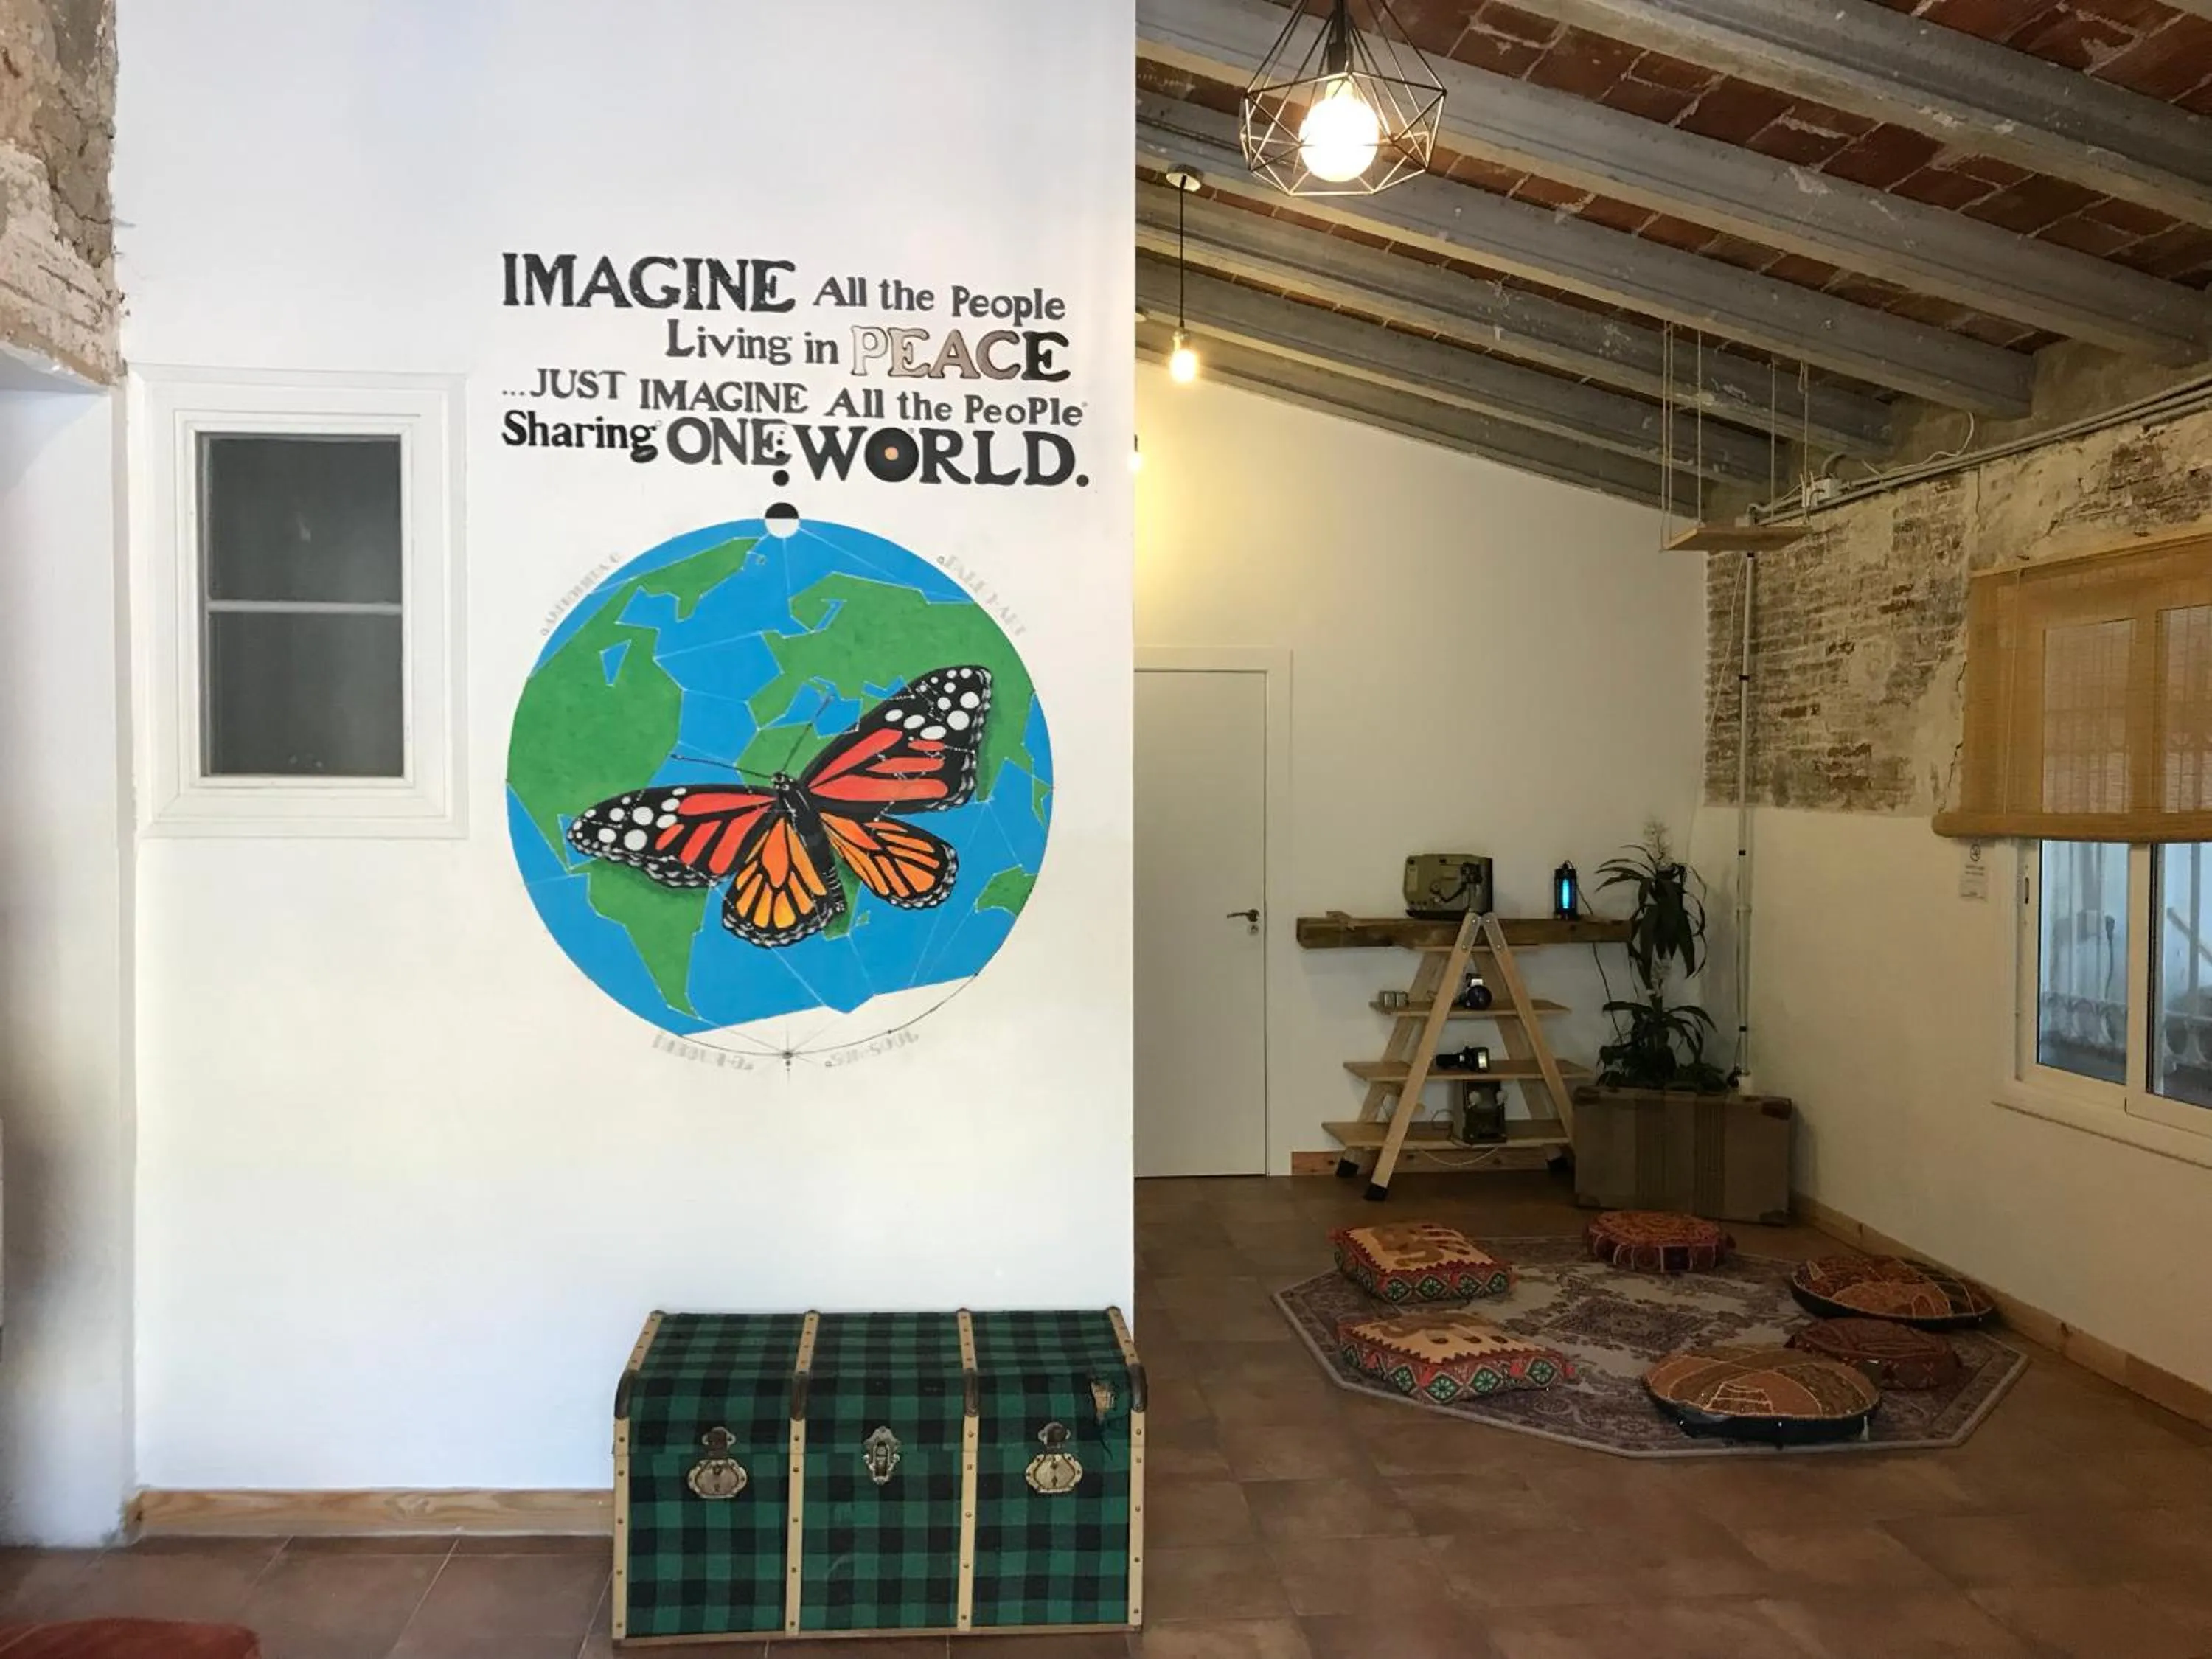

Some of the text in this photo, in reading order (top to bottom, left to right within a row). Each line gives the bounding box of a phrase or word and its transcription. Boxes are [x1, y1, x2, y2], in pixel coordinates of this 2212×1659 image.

[502, 252, 1066, 327] IMAGINE All the People
[665, 318, 1071, 382] Living in PEACE
[639, 378, 809, 414] IMAGINE
[824, 387, 885, 419] All
[896, 391, 953, 421] the
[501, 409, 659, 464] Sharing
